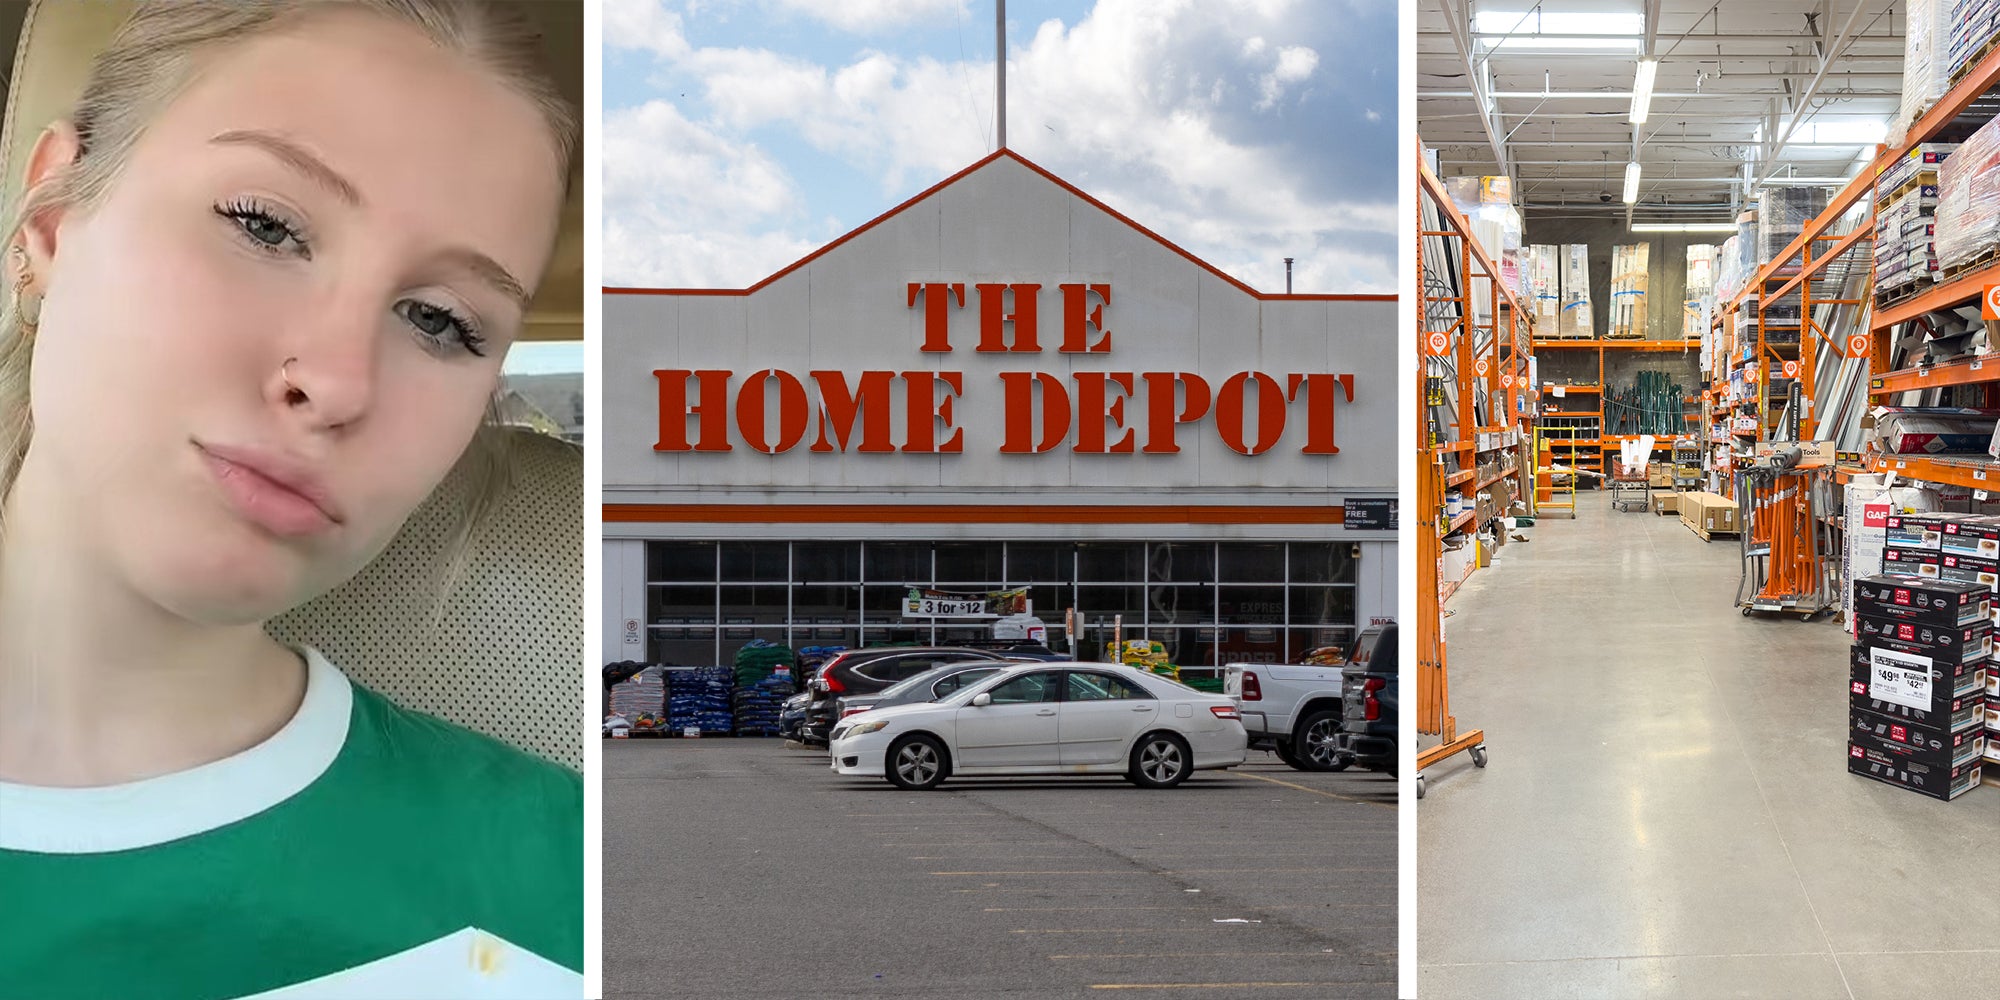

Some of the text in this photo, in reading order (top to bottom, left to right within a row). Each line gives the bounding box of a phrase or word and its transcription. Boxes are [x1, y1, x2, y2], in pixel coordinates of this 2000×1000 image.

[907, 283, 1111, 353] THE
[653, 368, 1354, 456] HOME DEPOT
[1345, 510, 1367, 518] FREE
[1866, 511, 1888, 520] GAF
[925, 600, 981, 614] 3 for $12
